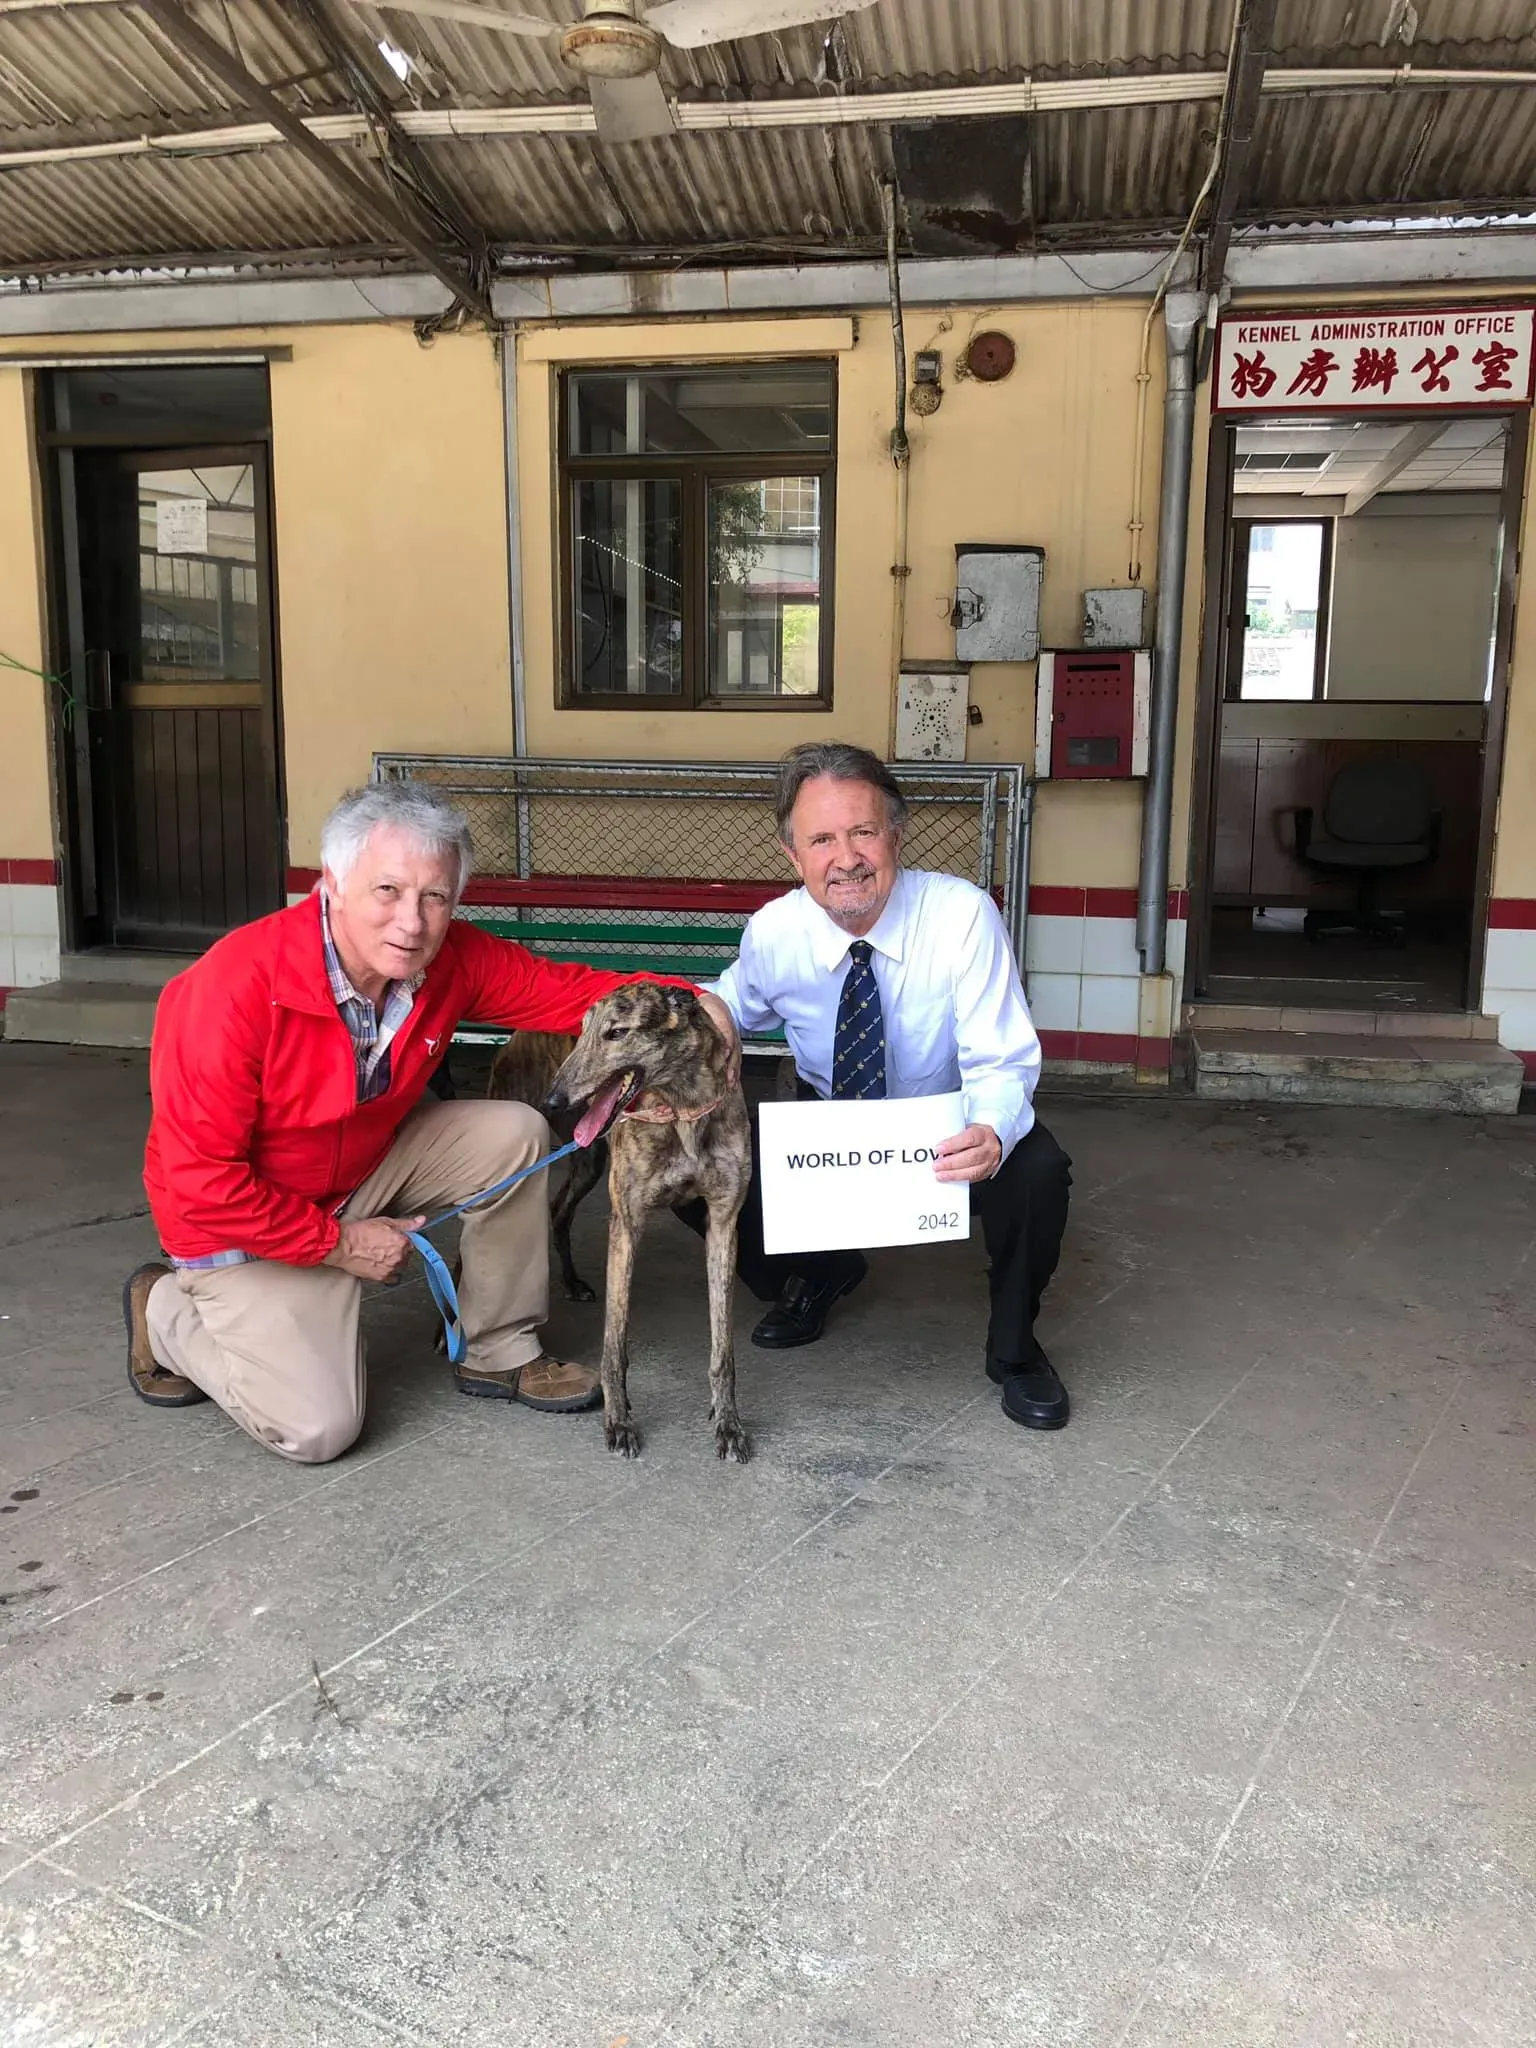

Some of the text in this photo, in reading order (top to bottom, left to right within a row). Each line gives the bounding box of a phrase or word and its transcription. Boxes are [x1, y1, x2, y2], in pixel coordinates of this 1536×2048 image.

[1238, 316, 1516, 344] KENNEL ADMINISTRATION OFFICE
[786, 1148, 940, 1169] WORLD OF LOV
[918, 1211, 960, 1231] 2042
